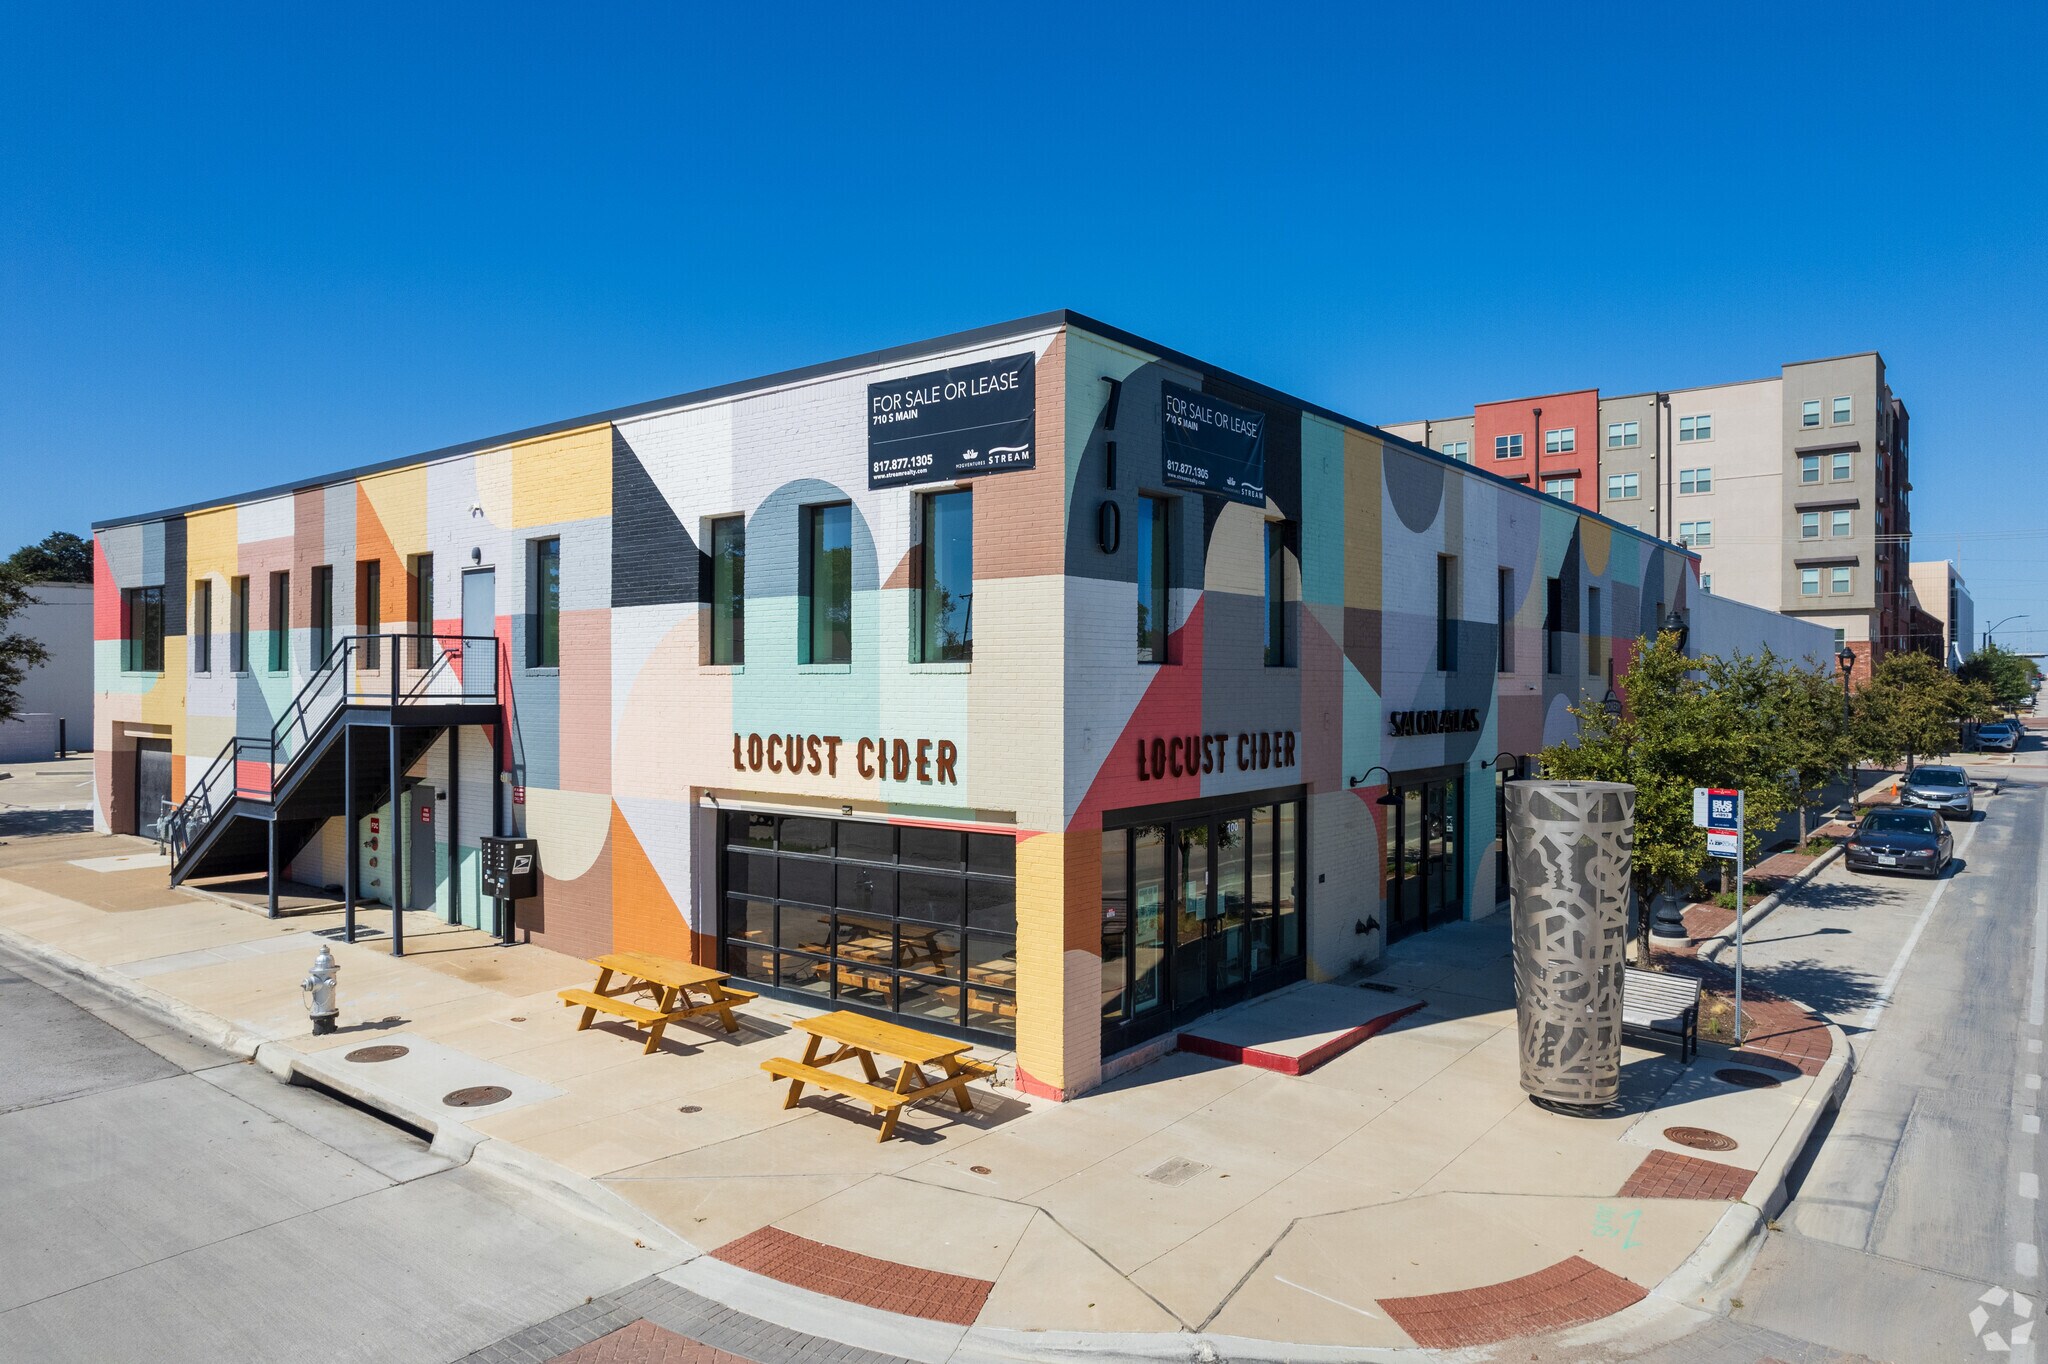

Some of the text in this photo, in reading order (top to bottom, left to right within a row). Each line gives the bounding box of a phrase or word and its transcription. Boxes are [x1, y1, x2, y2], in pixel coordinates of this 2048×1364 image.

[873, 371, 1019, 413] FOR SALE OR LEASE
[872, 409, 918, 425] 710 S MAIN
[1165, 413, 1199, 432] 710 S MAIN
[1166, 394, 1258, 438] FOR SALE OR LEASE
[873, 454, 933, 473] 817.877.1305
[988, 451, 1030, 465] STREAM
[873, 468, 928, 480] www.streamrealty.com
[1166, 459, 1209, 480] 817.877.1305
[1241, 488, 1264, 500] STREAM
[733, 732, 958, 784] LOCUST CIDER
[1138, 731, 1296, 781] LOCUST CIDER
[1712, 799, 1732, 807] BUS
[1226, 822, 1239, 833] 100
